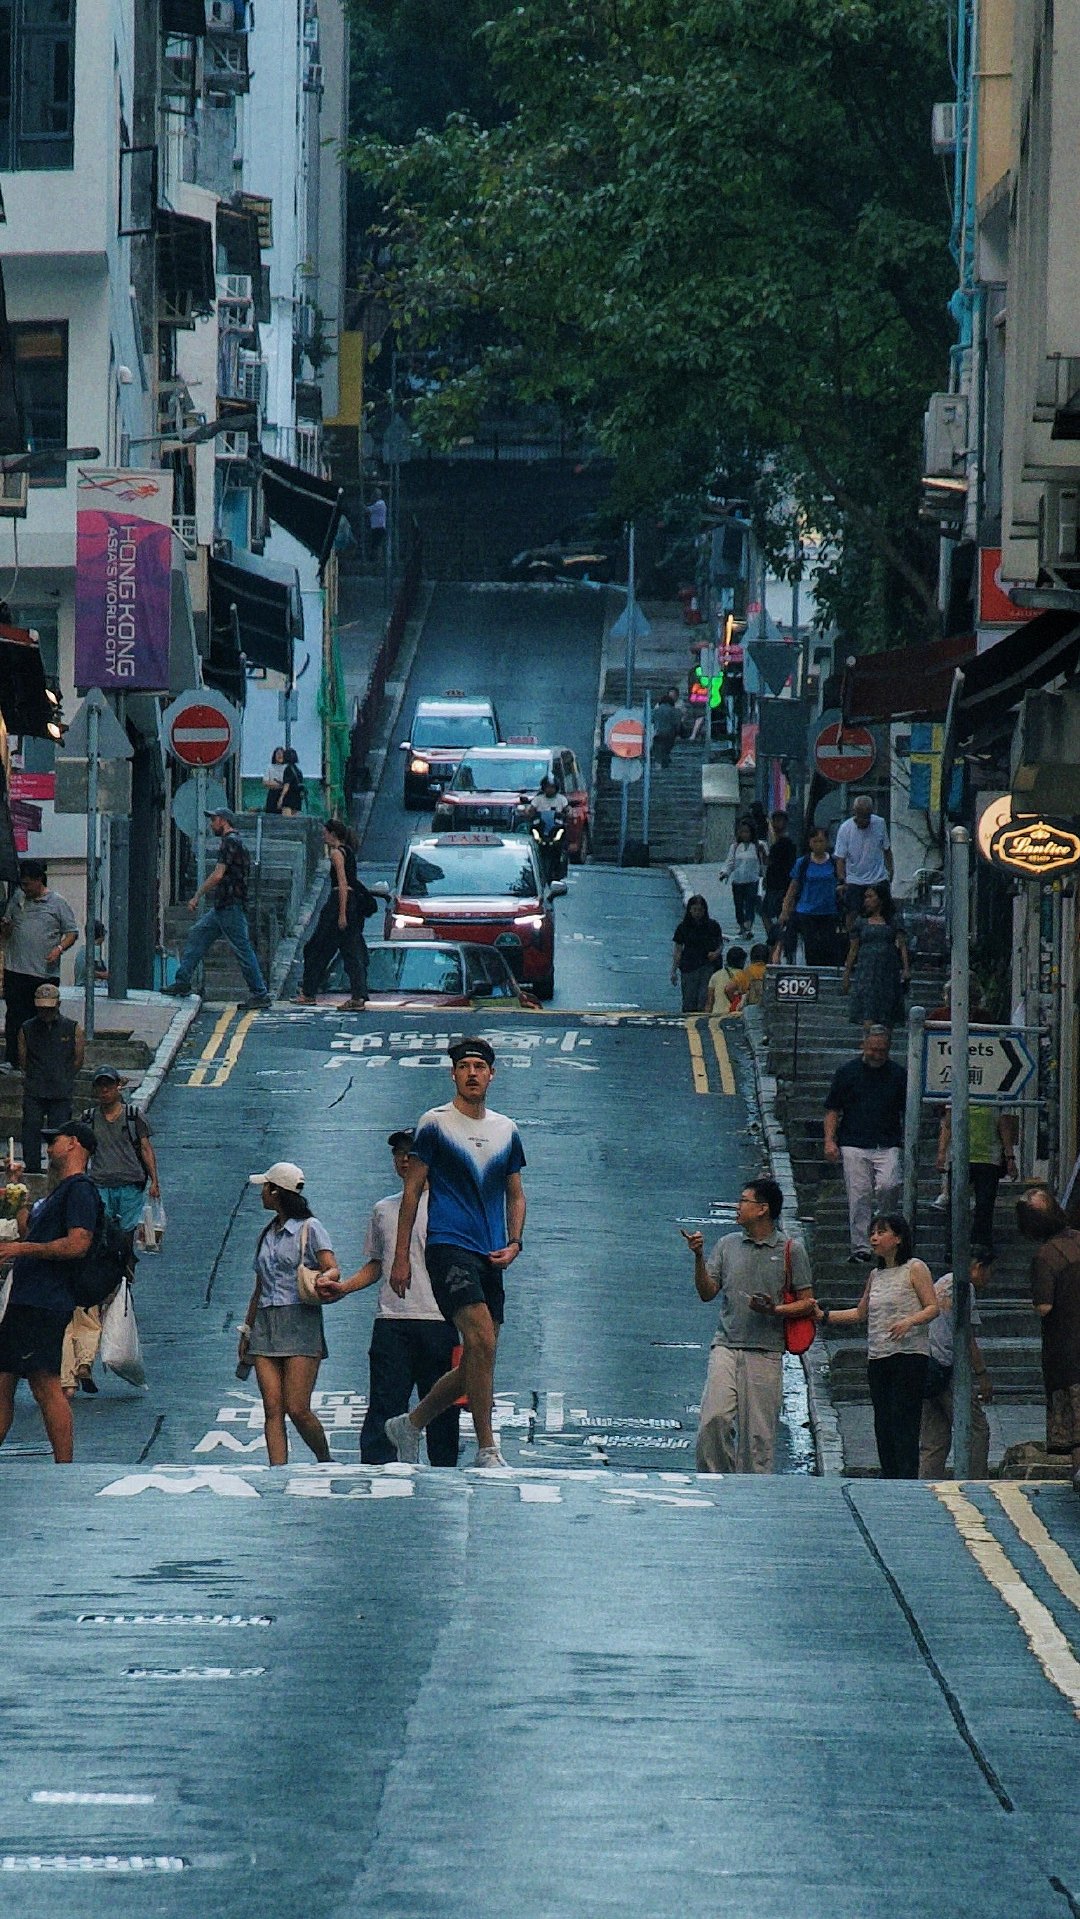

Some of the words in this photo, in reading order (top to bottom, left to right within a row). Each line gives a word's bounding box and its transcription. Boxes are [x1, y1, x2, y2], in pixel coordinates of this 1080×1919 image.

[106, 526, 119, 577] ASIA'S
[118, 525, 137, 600] HONG
[105, 579, 118, 636] WORLD
[105, 638, 116, 676] CITY
[116, 603, 136, 677] KONG
[447, 834, 493, 843] TAXI
[777, 979, 816, 995] 30%
[937, 1041, 994, 1056] Tets
[95, 1473, 717, 1508] SLOW
